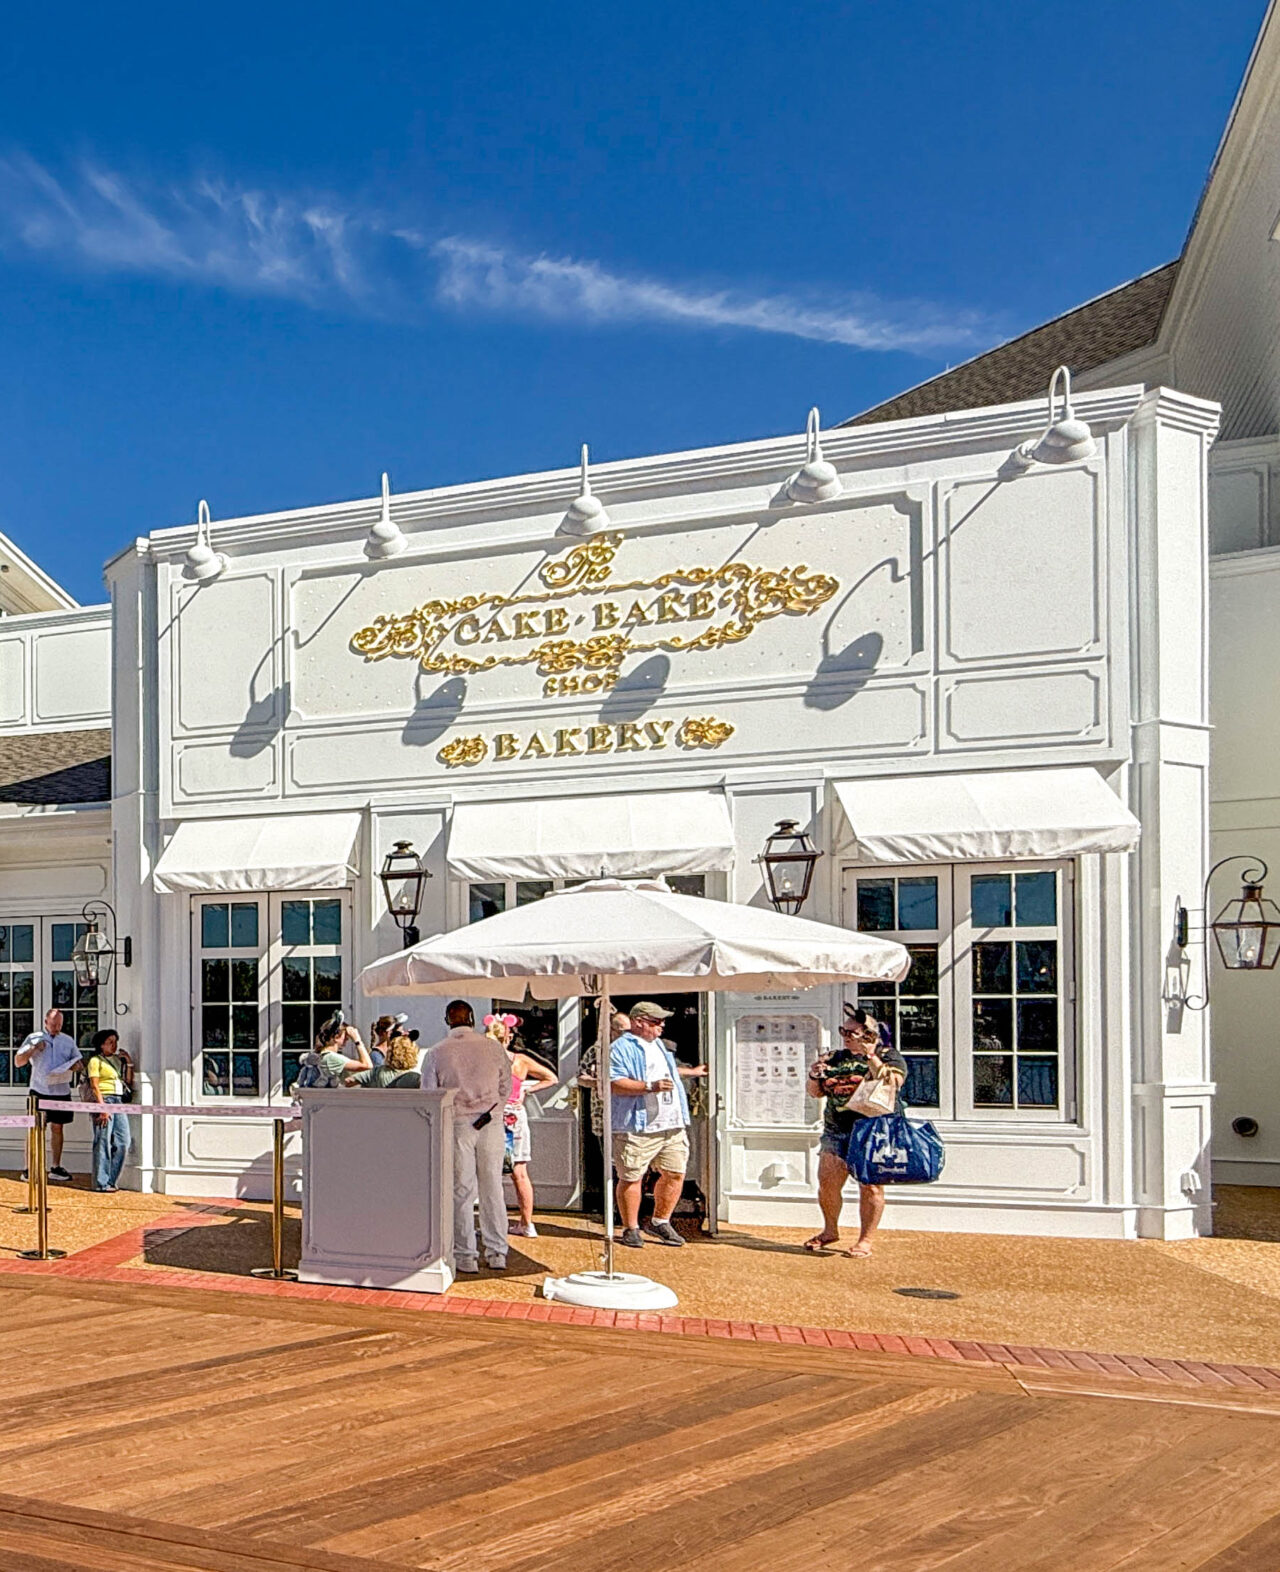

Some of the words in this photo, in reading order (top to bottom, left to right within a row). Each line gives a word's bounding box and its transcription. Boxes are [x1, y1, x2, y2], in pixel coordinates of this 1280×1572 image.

[538, 540, 620, 589] The
[455, 607, 569, 645] CAKE
[592, 591, 716, 631] BAKE
[543, 672, 620, 698] SHOP
[493, 719, 673, 762] BAKERY
